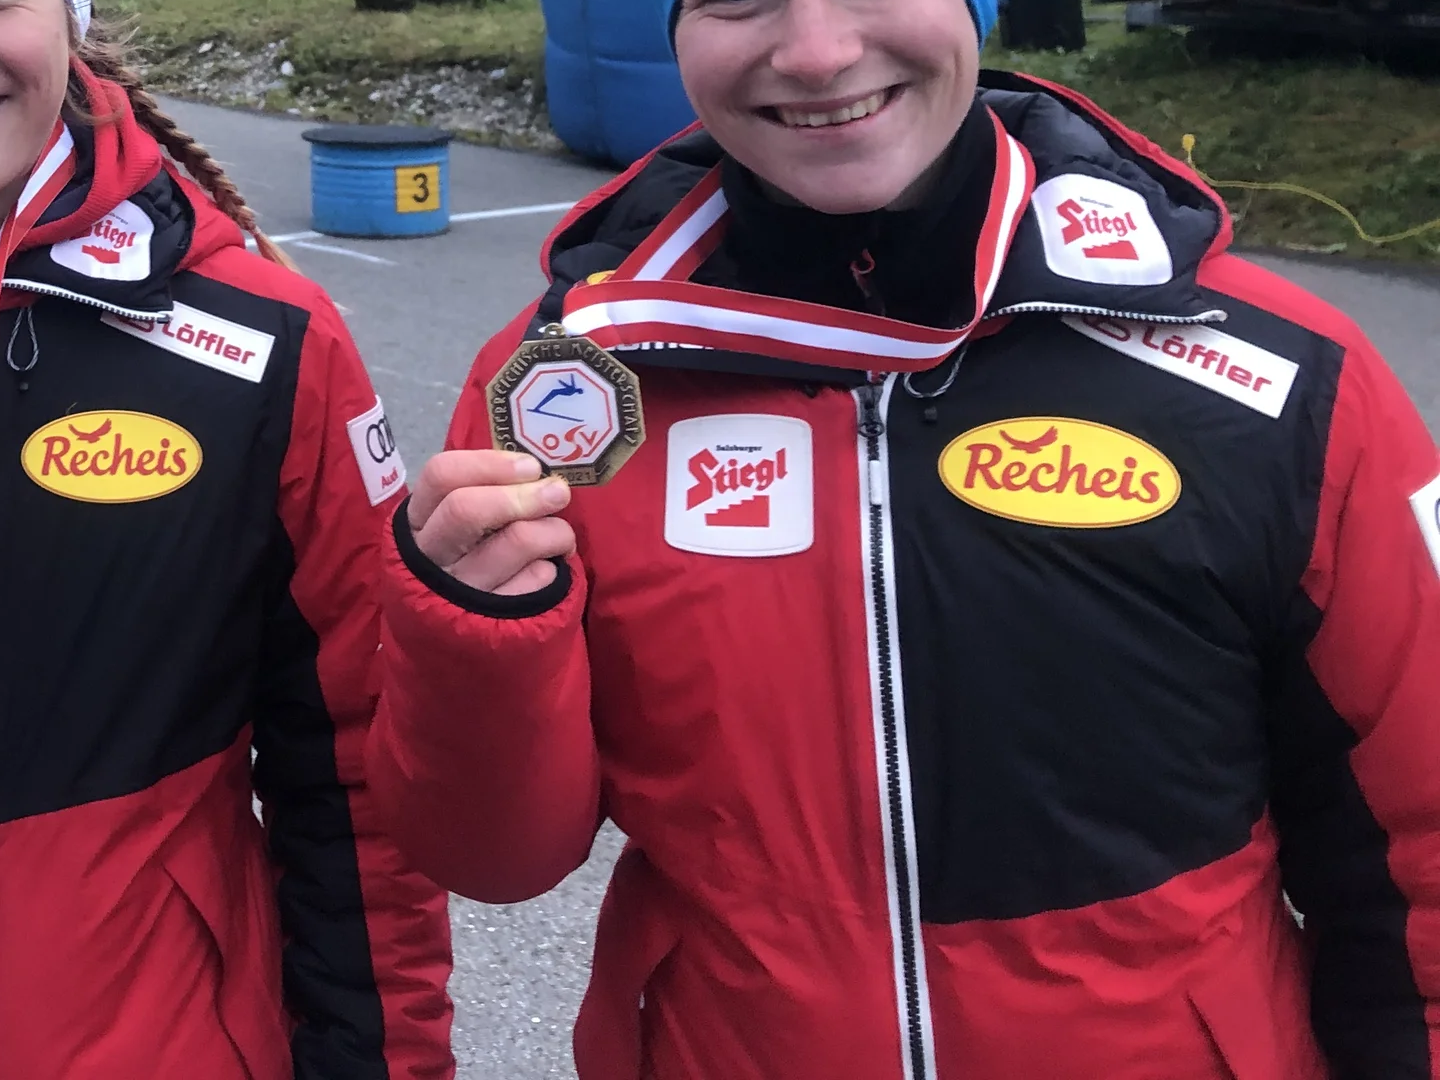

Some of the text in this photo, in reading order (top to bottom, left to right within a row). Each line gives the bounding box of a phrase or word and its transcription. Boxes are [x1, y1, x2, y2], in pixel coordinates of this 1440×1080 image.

[412, 172, 429, 203] 3
[91, 219, 136, 249] tiegl
[1056, 198, 1137, 245] Stiegl
[162, 322, 256, 366] Löffler
[1143, 326, 1273, 394] Löffler
[42, 433, 187, 476] Recheis
[963, 444, 1160, 504] Recheis
[686, 447, 788, 511] Stiegl
